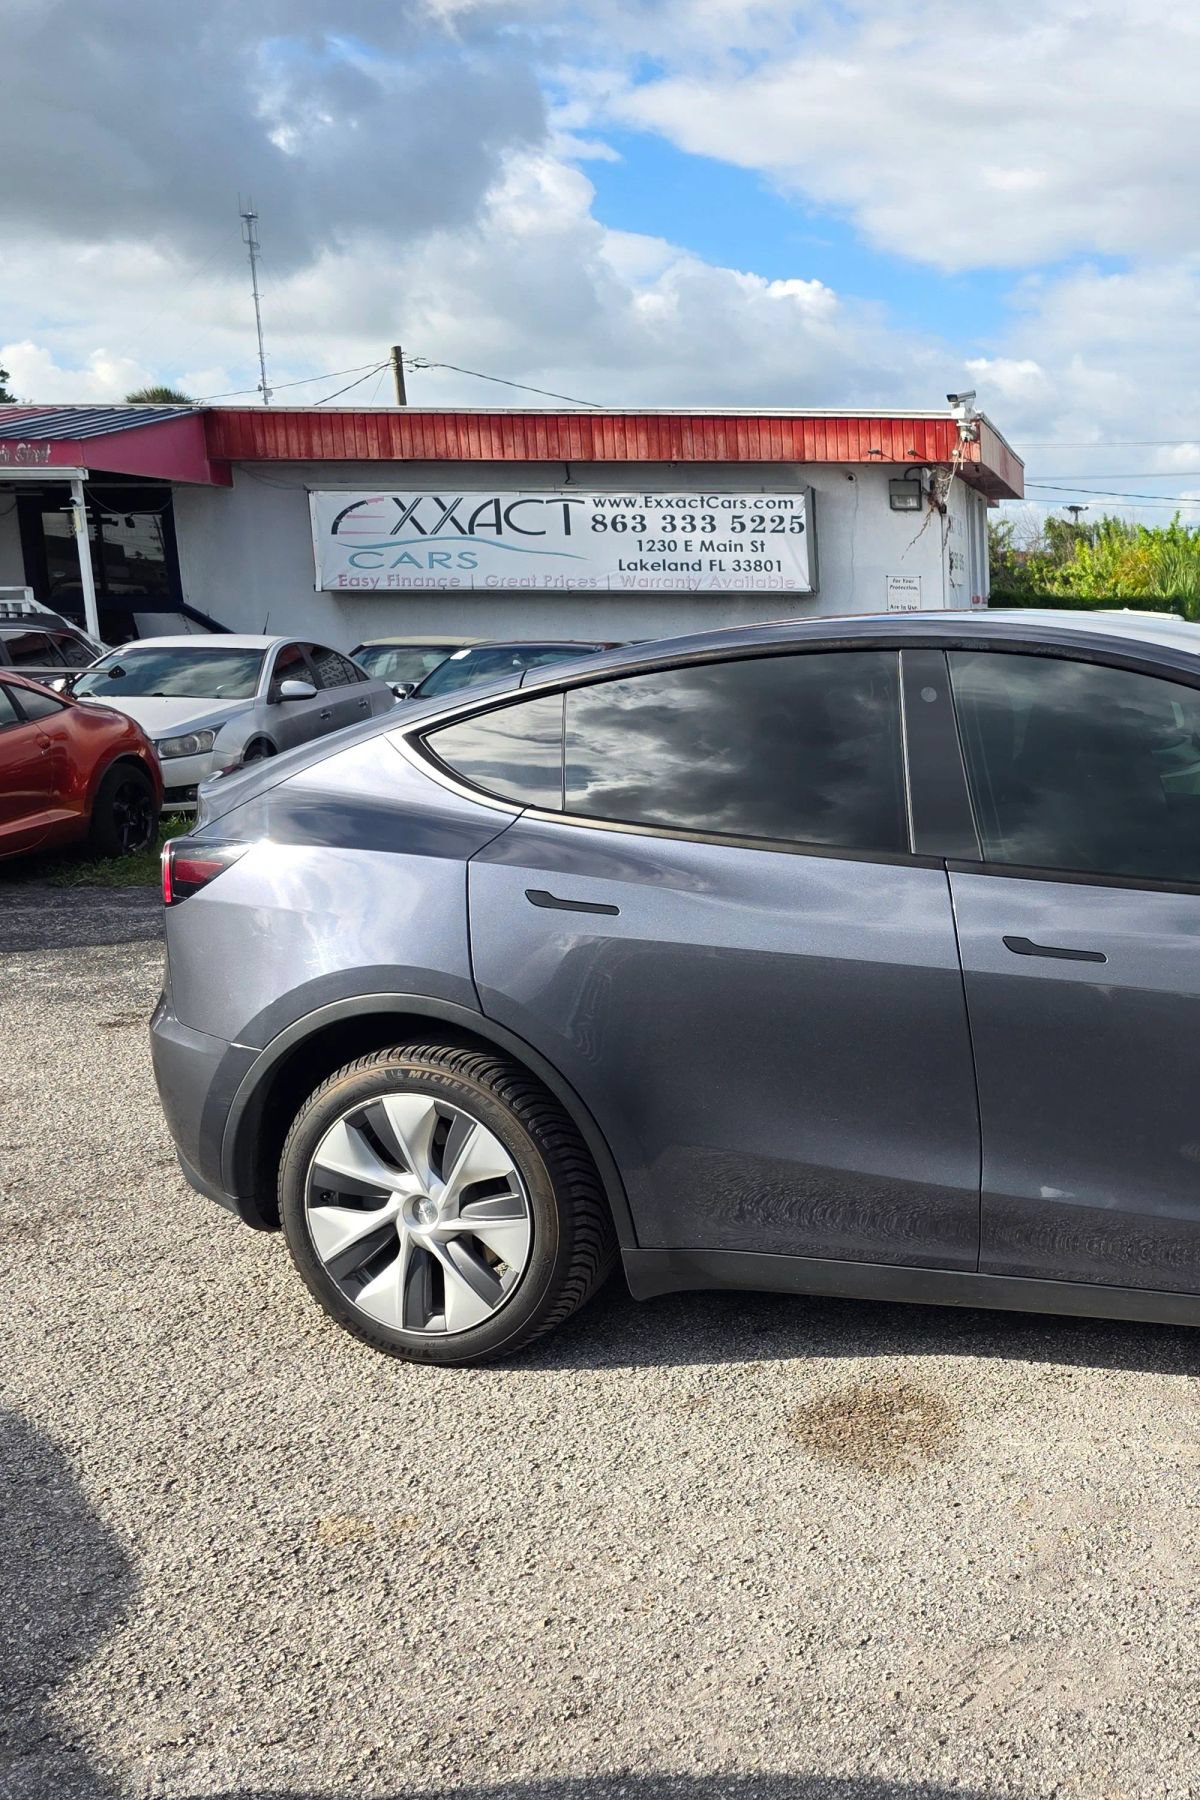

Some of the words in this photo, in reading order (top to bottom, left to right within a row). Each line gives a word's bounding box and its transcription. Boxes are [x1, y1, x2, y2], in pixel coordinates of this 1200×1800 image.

[593, 496, 794, 509] www.ExxactCars.com
[331, 496, 585, 535] EXXACT
[591, 514, 647, 533] 863
[661, 514, 717, 533] 333
[730, 514, 805, 534] 5225
[637, 539, 678, 552] 1230
[684, 540, 693, 552] E
[700, 540, 744, 552] Main
[750, 540, 765, 553] St
[348, 552, 478, 569] CARS
[618, 559, 702, 572] Lakeland
[709, 560, 726, 572] FL
[732, 560, 782, 572] 33801
[338, 574, 379, 590] Easy
[387, 574, 461, 588] Finance
[485, 574, 537, 588] Great
[544, 575, 597, 588] Prices
[621, 575, 701, 590] Warranty
[709, 575, 795, 589] Available
[408, 1070, 496, 1110] MICHELIN
